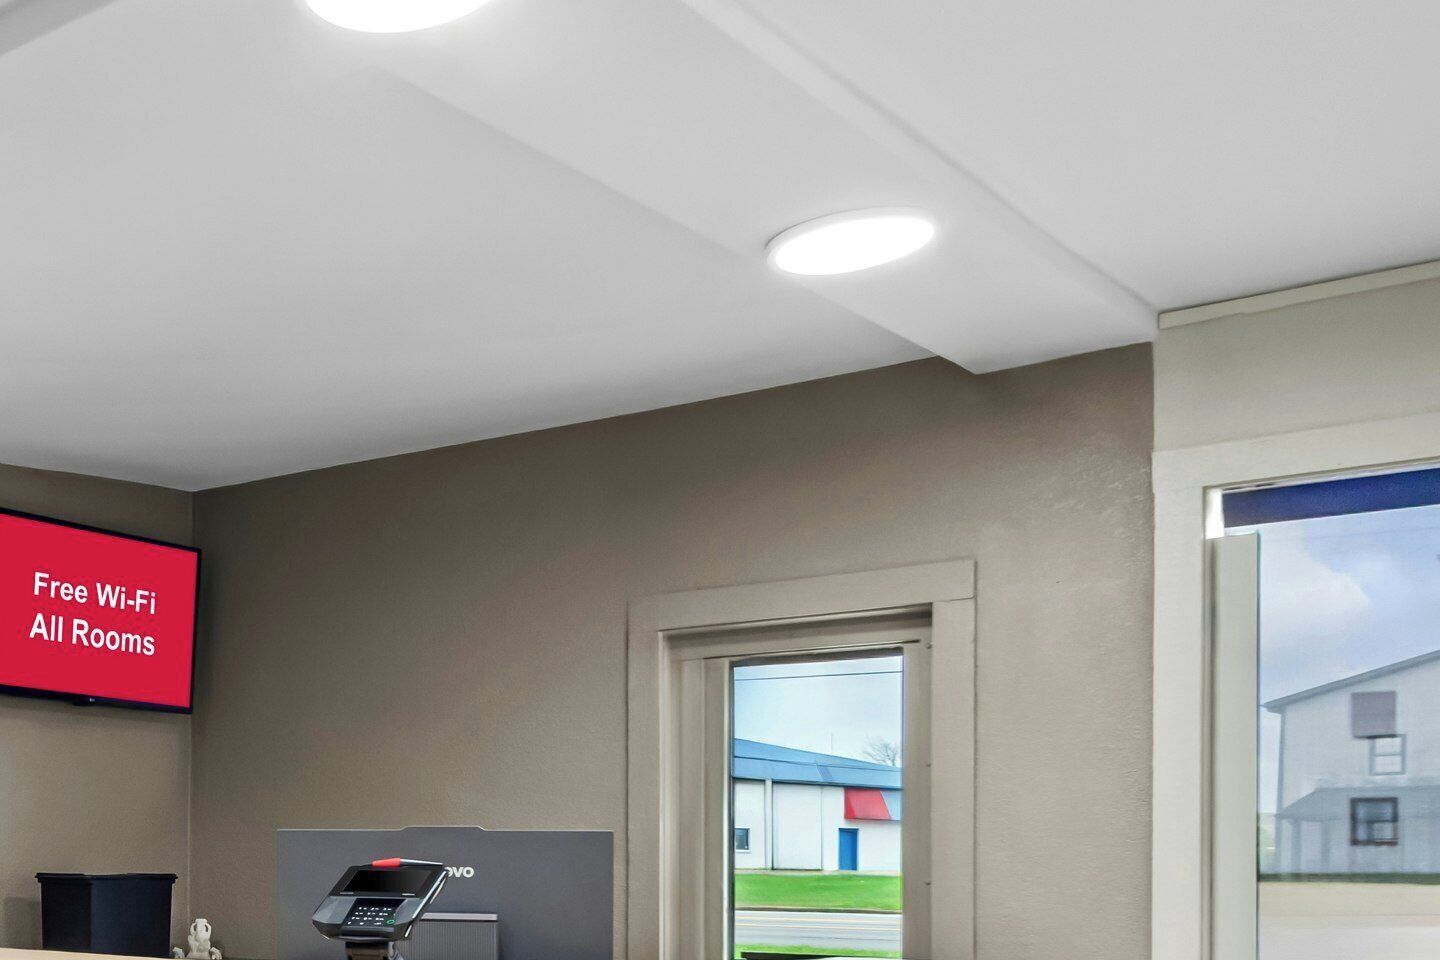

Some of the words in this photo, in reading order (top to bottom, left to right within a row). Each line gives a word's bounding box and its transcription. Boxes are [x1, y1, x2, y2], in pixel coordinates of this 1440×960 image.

[34, 572, 88, 603] Free
[96, 583, 156, 614] Wi-Fi
[29, 612, 64, 642] All
[72, 618, 155, 656] Rooms
[444, 866, 474, 878] ovo
